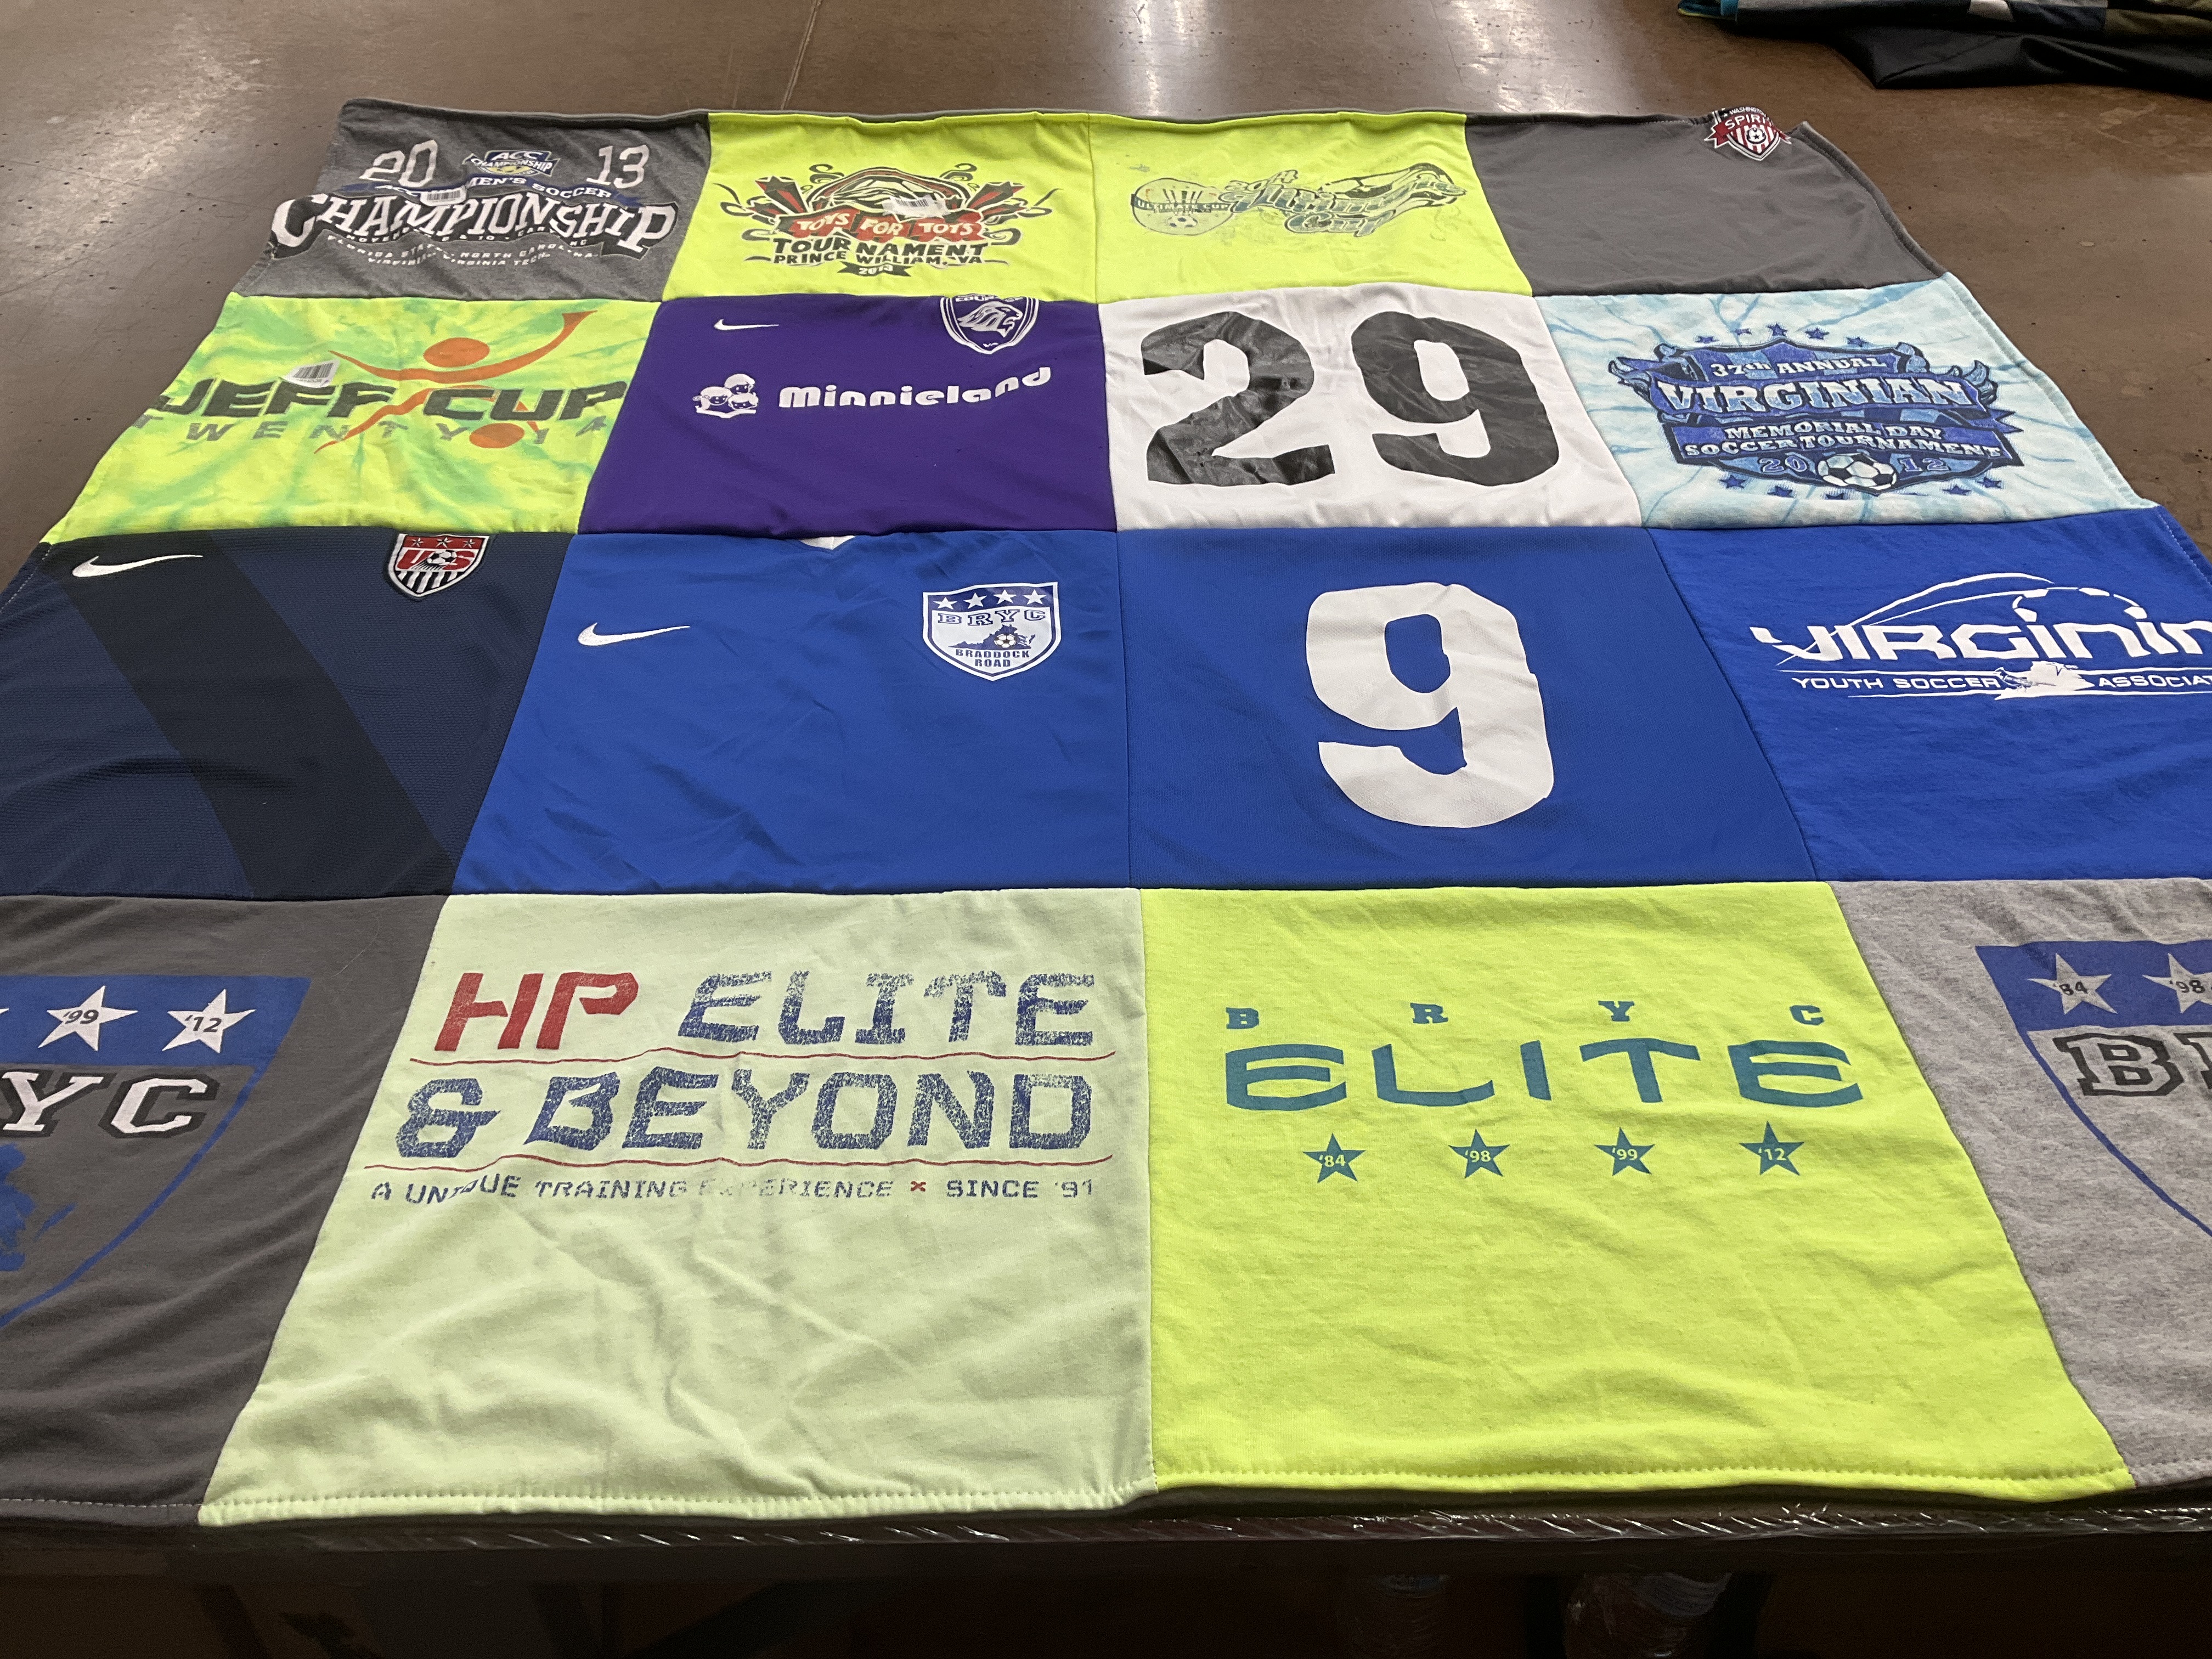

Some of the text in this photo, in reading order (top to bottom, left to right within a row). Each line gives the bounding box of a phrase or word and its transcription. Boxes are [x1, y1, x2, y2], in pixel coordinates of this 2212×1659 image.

[358, 139, 650, 189] 20 13
[470, 158, 553, 173] CHAMPIONSHIP
[490, 150, 543, 161] ACC
[532, 184, 612, 199] SOCCER
[271, 191, 677, 253] CHAMPIONSHIP
[796, 212, 974, 235] TOYS FOR TOTS
[772, 251, 847, 264] PRINCE
[959, 256, 983, 264] VA
[1709, 357, 1888, 377] 37th ANNUAL
[778, 366, 1051, 408] Minnieland
[1657, 377, 1971, 413] VIRGINIAN
[423, 381, 627, 421] CUP
[1140, 311, 1560, 487] 29
[1724, 421, 1942, 440] MEMORIAL DAY
[1684, 435, 2002, 457] SOCCER TOURNAMENT
[1758, 455, 1949, 472] 20 12
[938, 608, 1046, 626] BRYC
[955, 649, 1030, 658] BRADDOCK
[974, 658, 1011, 667] ROAD
[1791, 677, 1883, 690] YOUTH
[1895, 677, 2001, 690] SOCCER
[1305, 582, 1554, 828] 9
[434, 969, 1096, 1052] HP ELITE
[1226, 1037, 1864, 1111] ELITE
[394, 1066, 1092, 1159] & BEYOND
[370, 1181, 392, 1201] A
[534, 1179, 688, 1199] TRAINING
[946, 1179, 1039, 1199] SINCE
